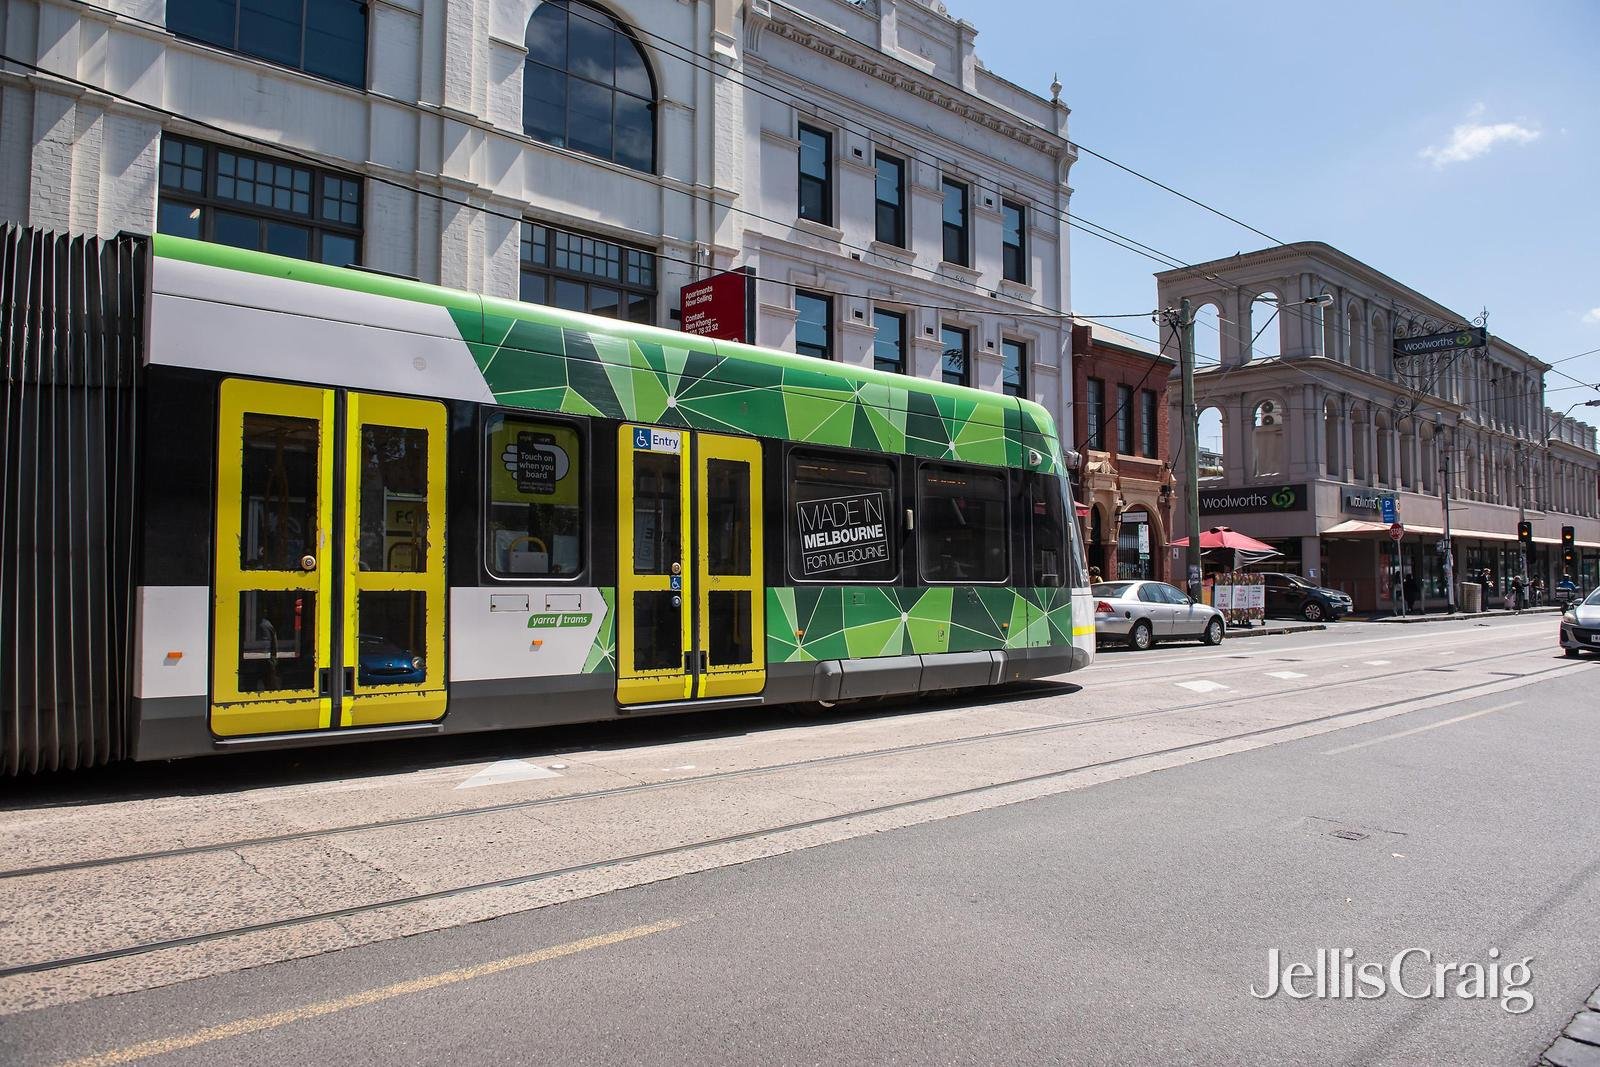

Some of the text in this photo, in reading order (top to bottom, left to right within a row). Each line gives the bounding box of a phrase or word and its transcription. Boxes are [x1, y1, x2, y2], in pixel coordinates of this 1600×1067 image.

[685, 285, 713, 300] Apartments
[685, 294, 713, 308] Now Selling
[685, 311, 705, 323] Contact
[685, 322, 696, 331] Ben
[696, 318, 712, 328] Khong
[1404, 337, 1454, 352] woolworths
[653, 434, 679, 449] Entry
[521, 451, 543, 462] Touch
[520, 461, 554, 472] when you
[526, 471, 548, 479] board
[1202, 493, 1268, 509] woolworths
[1385, 500, 1391, 508] P
[800, 497, 882, 532] MADE IN
[804, 524, 884, 549] MELBOURNE
[806, 544, 886, 570] FOR MELBOURNE
[533, 615, 588, 627] yarra trams
